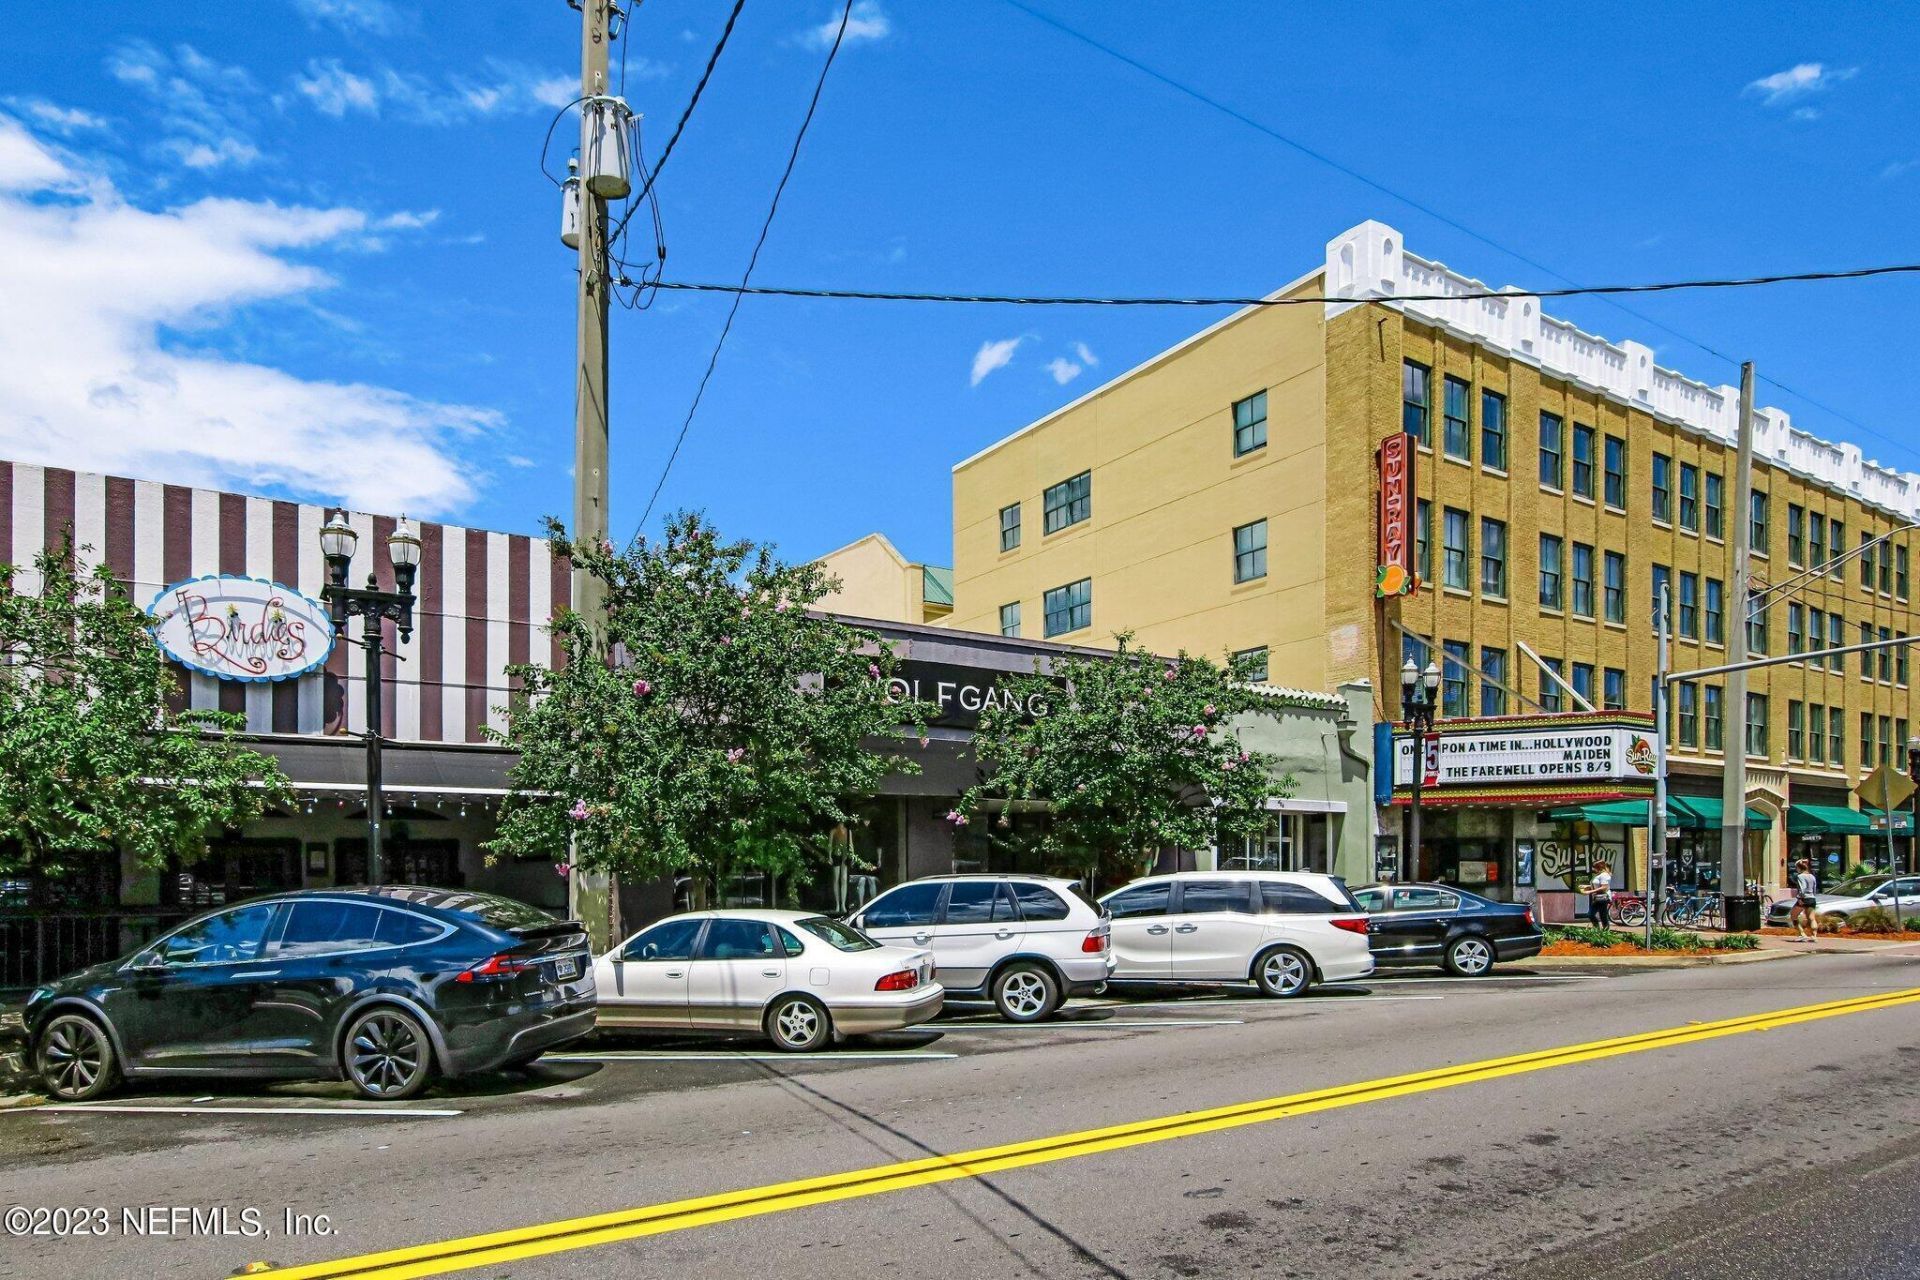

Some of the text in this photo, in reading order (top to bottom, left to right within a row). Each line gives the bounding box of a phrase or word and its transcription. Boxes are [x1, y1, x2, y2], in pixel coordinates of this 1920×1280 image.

[176, 590, 305, 674] Birdies
[865, 677, 1048, 717] OLFGANG
[1426, 741, 1439, 770] 5
[1442, 743, 1465, 753] PON
[1469, 742, 1476, 752] A
[1480, 741, 1506, 751] TIME
[1563, 749, 1611, 760] MAIDEN
[1446, 767, 1468, 777] THE
[1472, 764, 1534, 776] FAREWELL
[1540, 763, 1582, 774] OPENS
[1587, 762, 1611, 772] 8/9
